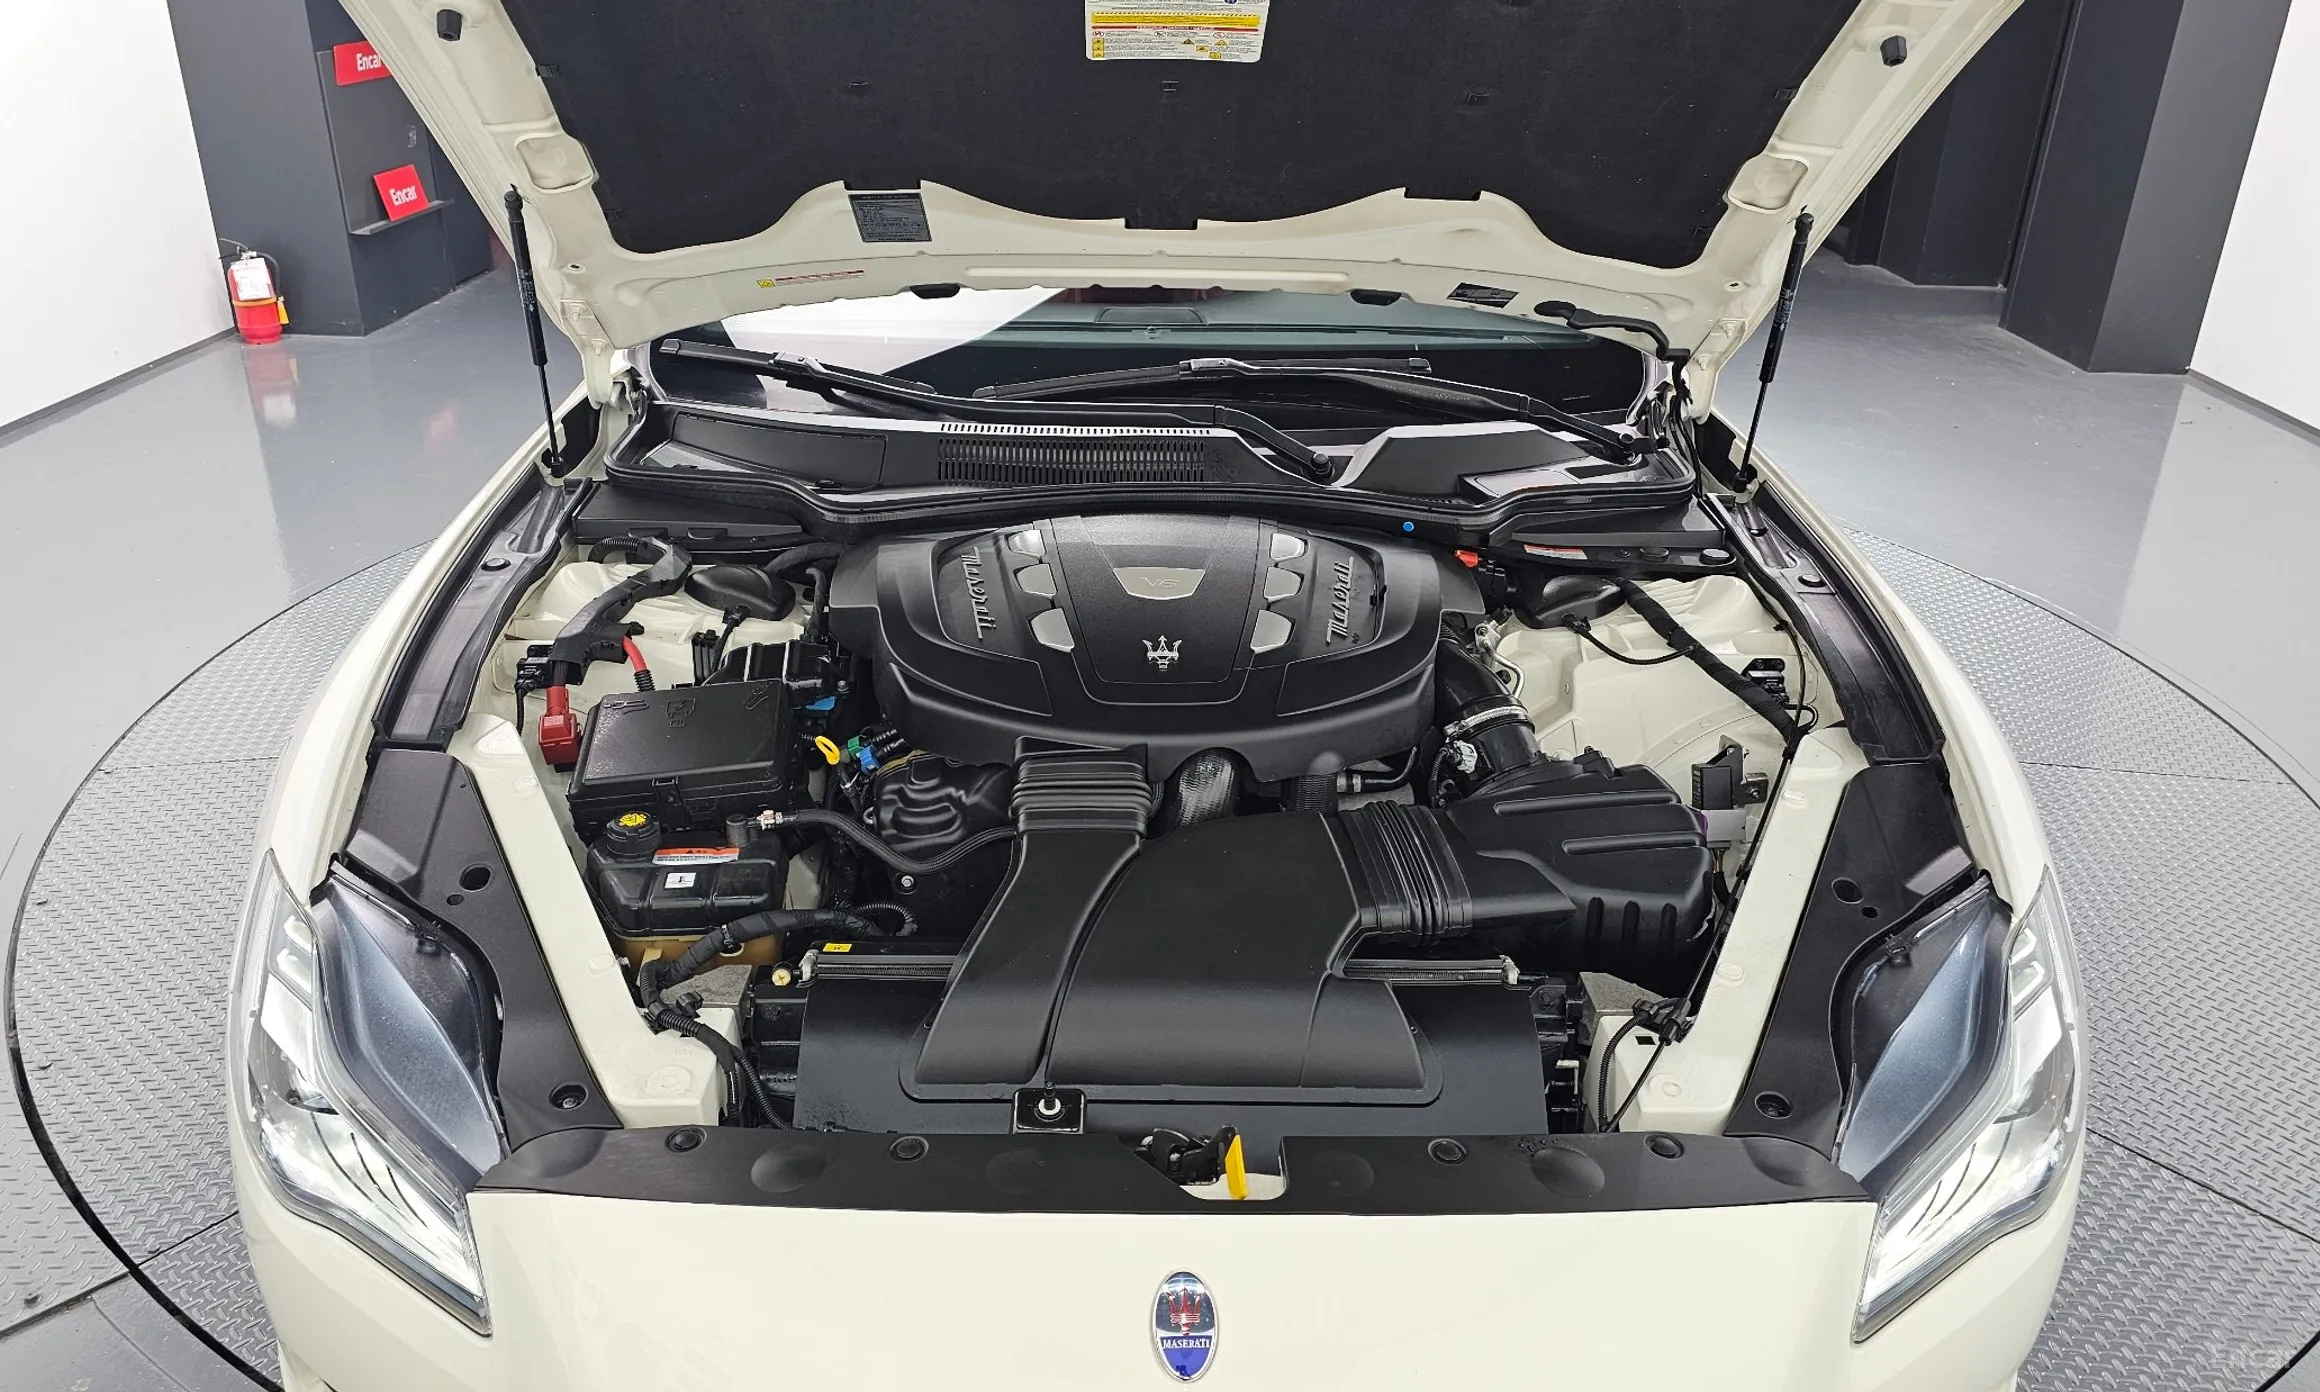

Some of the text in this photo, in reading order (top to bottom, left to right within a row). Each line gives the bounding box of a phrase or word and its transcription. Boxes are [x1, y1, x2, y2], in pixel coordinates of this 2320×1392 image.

[388, 185, 418, 206] Encar
[1140, 576, 1179, 589] V6
[1162, 1338, 1211, 1350] MASERATI
